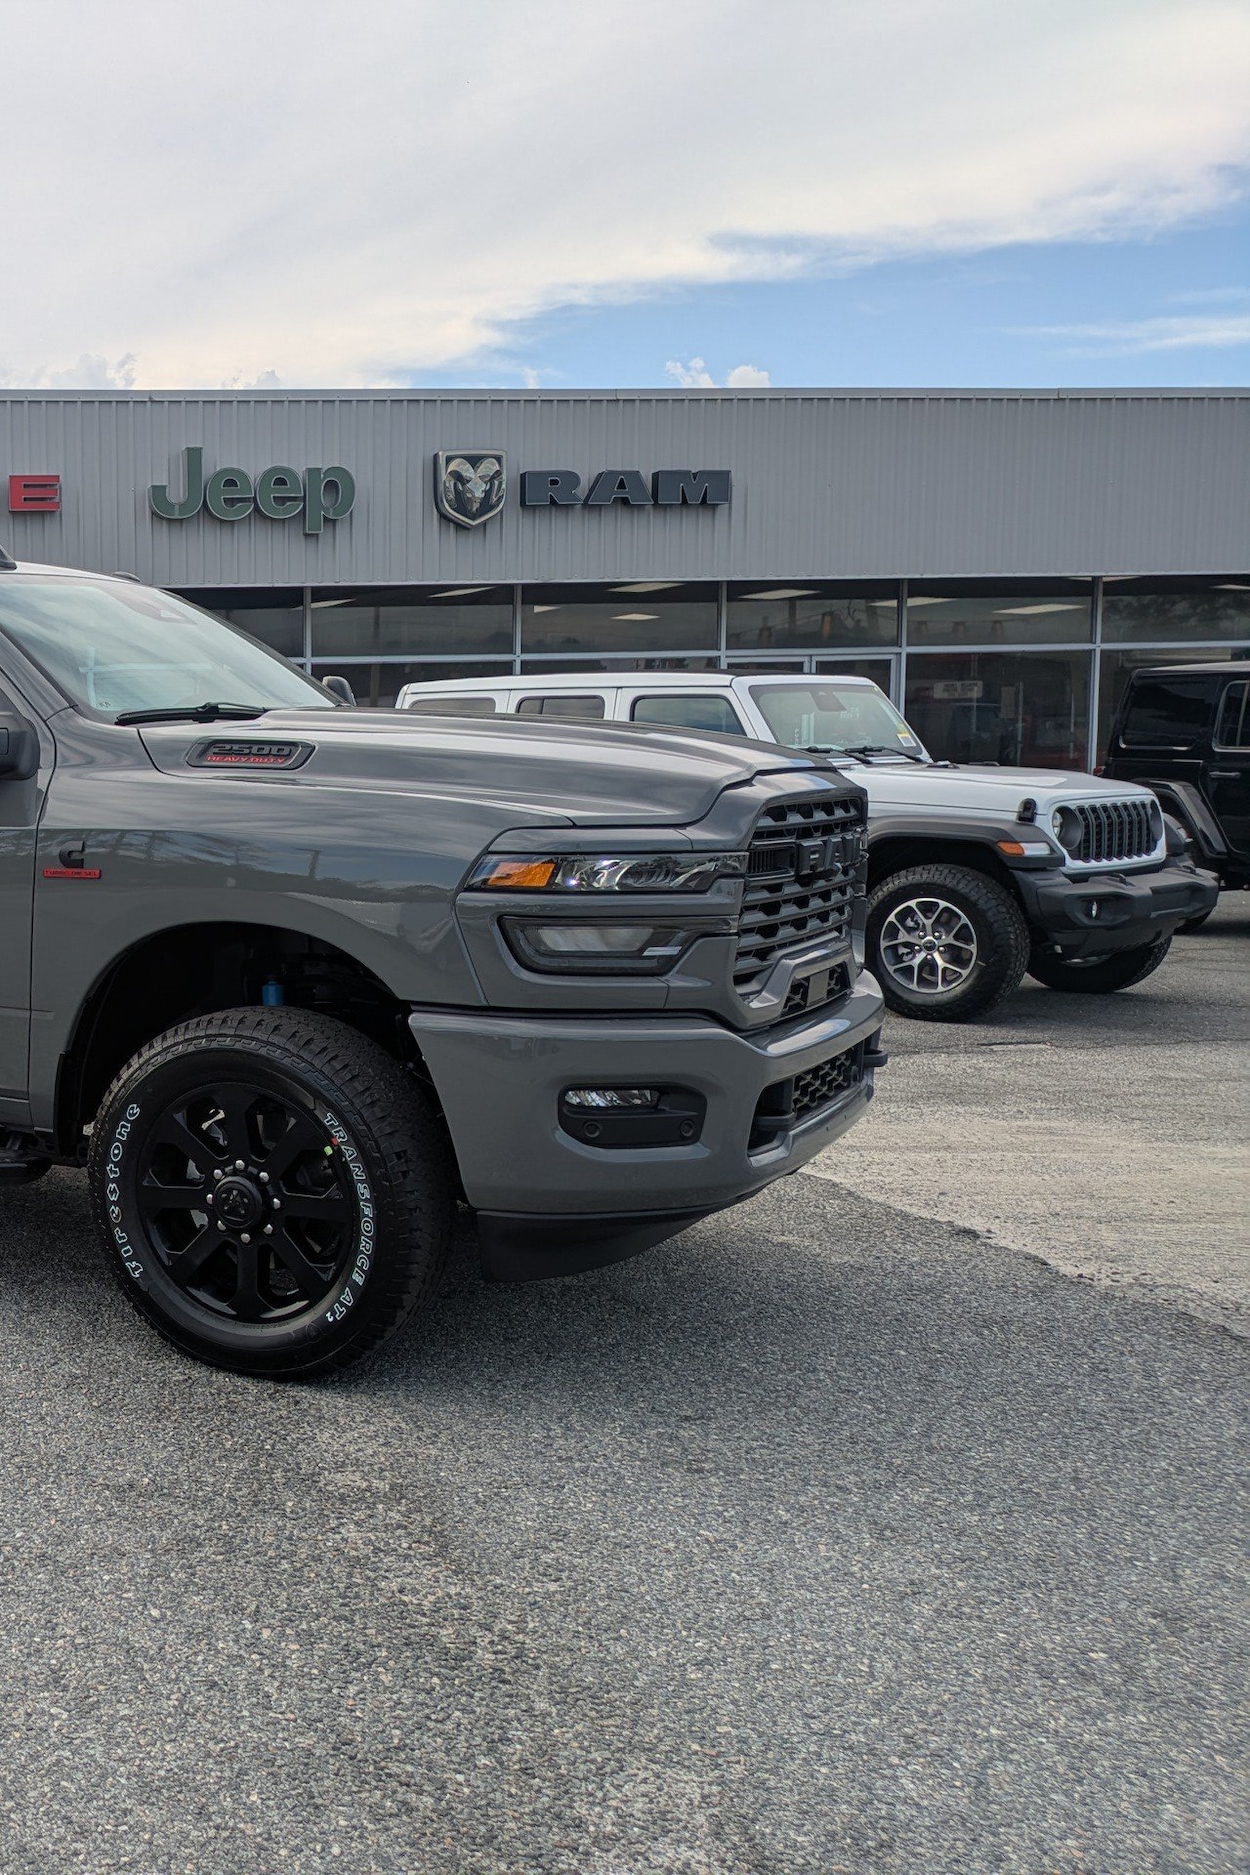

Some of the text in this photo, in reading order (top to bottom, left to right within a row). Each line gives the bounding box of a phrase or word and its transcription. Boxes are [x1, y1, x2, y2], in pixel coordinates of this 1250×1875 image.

[150, 446, 356, 534] Jeep
[520, 469, 732, 507] RAM
[207, 755, 249, 763] HEAVY
[212, 743, 292, 756] 2500
[106, 1103, 144, 1279] Firestone
[323, 1112, 375, 1287] TRANSFORCE
